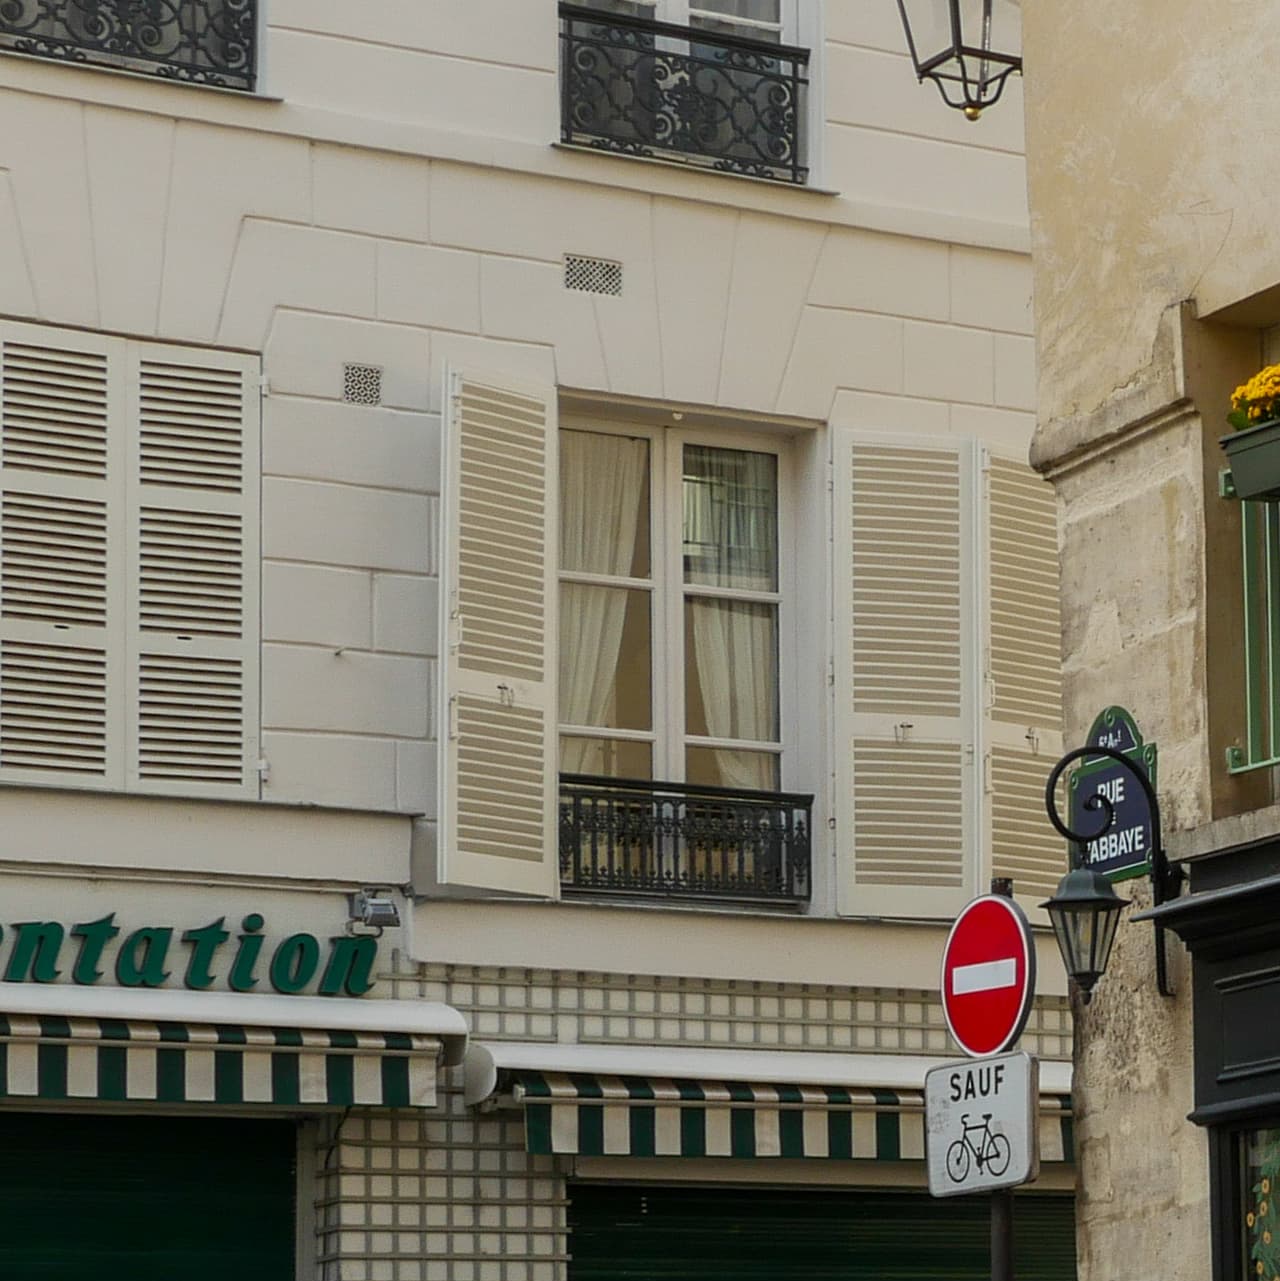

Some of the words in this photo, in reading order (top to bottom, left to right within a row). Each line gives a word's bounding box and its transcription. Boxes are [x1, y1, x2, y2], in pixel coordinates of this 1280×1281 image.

[1085, 825, 1145, 864] 'ABBAYE
[0, 912, 379, 998] ntation
[950, 1064, 1005, 1102] SAUF
